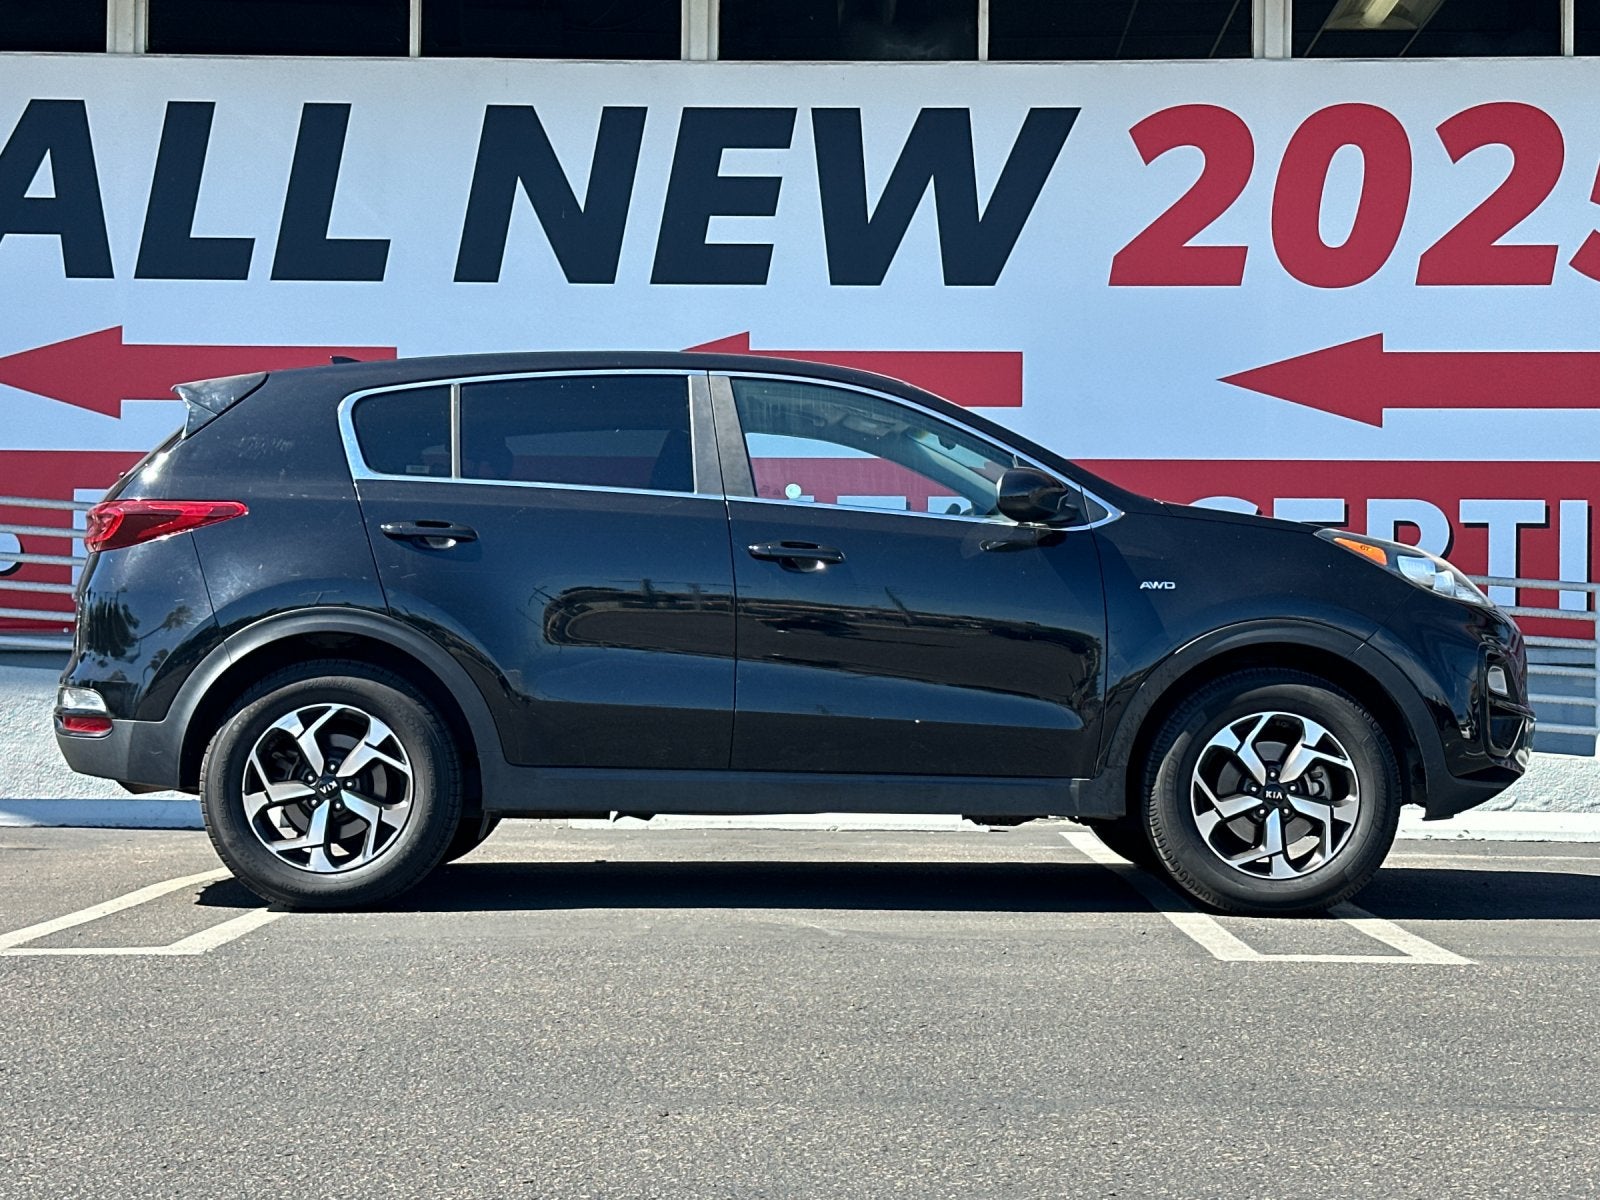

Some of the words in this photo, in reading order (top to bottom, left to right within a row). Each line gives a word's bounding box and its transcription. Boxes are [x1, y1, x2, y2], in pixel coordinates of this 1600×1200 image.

[0, 99, 390, 281] ALL
[454, 105, 1081, 286] NEW
[1111, 103, 1600, 287] 202
[1139, 581, 1176, 589] AWD
[319, 780, 338, 794] KIA
[1265, 790, 1283, 800] KIA
